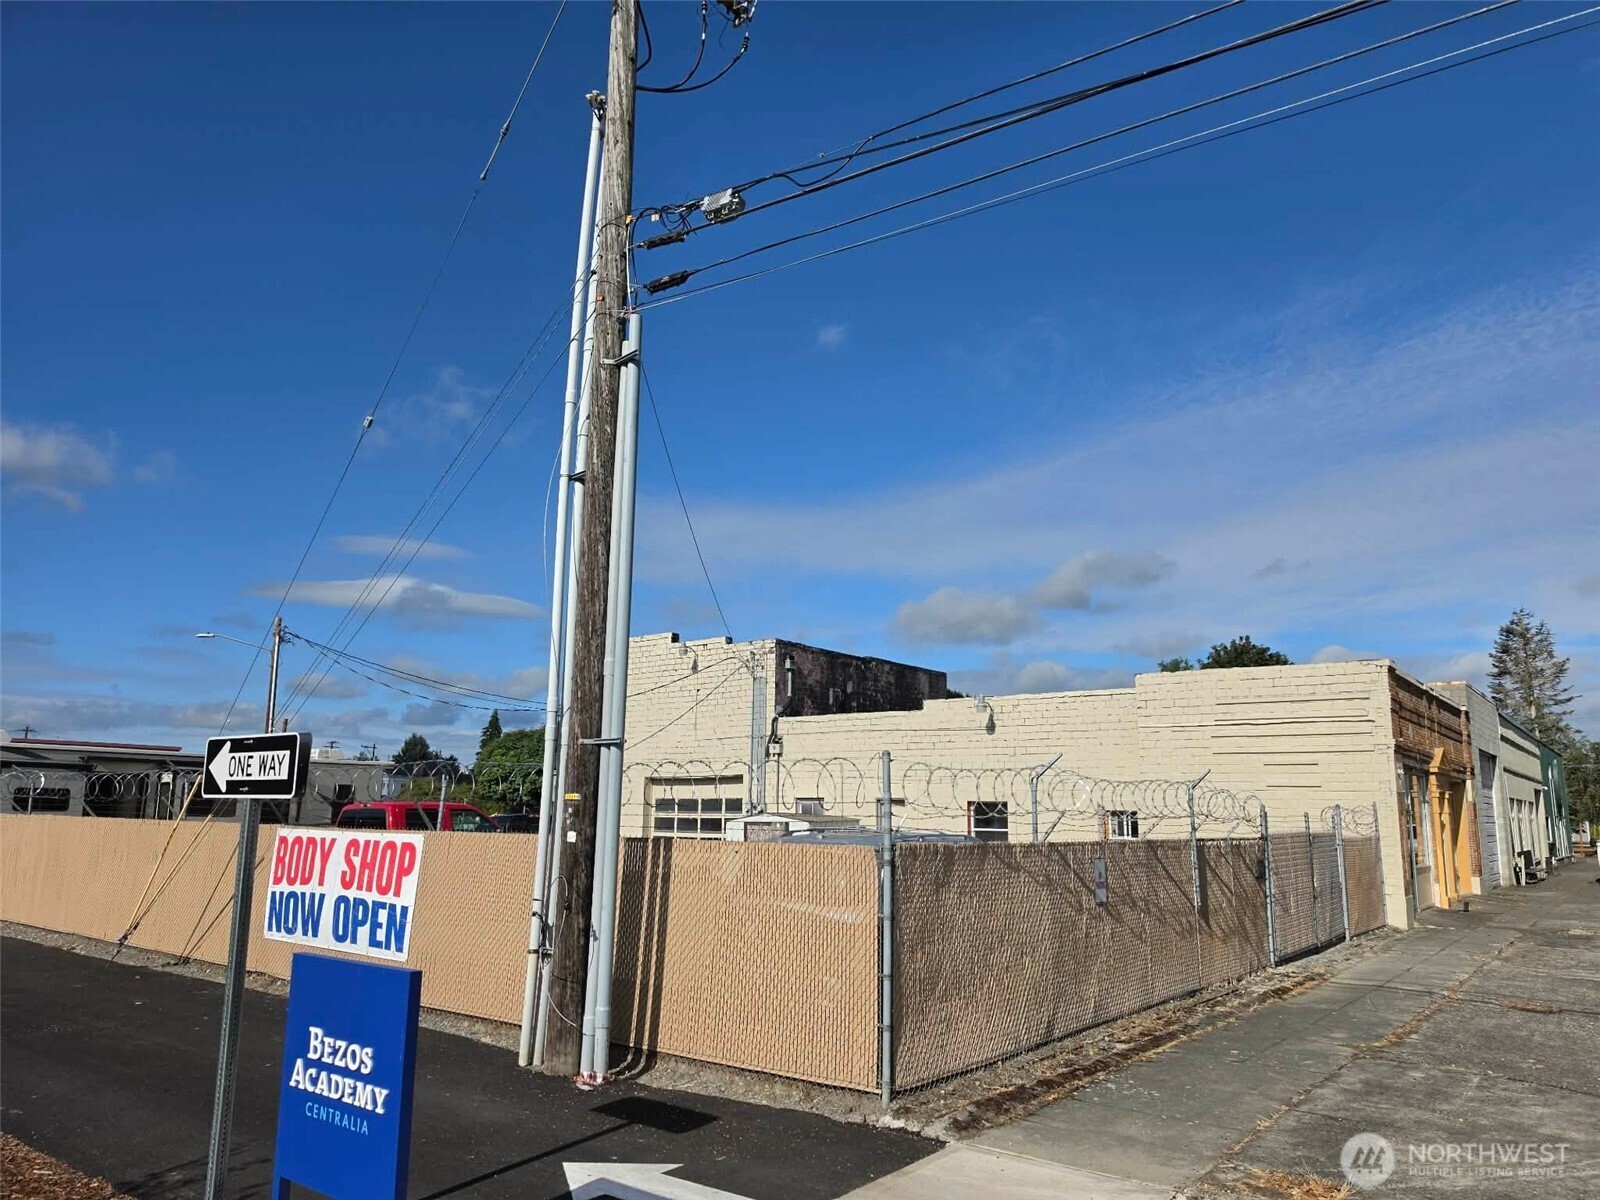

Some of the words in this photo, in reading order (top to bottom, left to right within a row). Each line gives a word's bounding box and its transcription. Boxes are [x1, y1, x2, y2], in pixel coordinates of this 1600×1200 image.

[229, 755, 253, 777] ONE
[259, 753, 286, 777] WAY
[272, 835, 337, 887] BODY
[340, 838, 417, 898] SHOP
[267, 890, 326, 938] NOW
[331, 895, 409, 953] OPEN
[307, 1026, 374, 1075] BEZOS
[289, 1058, 390, 1115] ACADEMY
[305, 1102, 369, 1136] CENTRALIA
